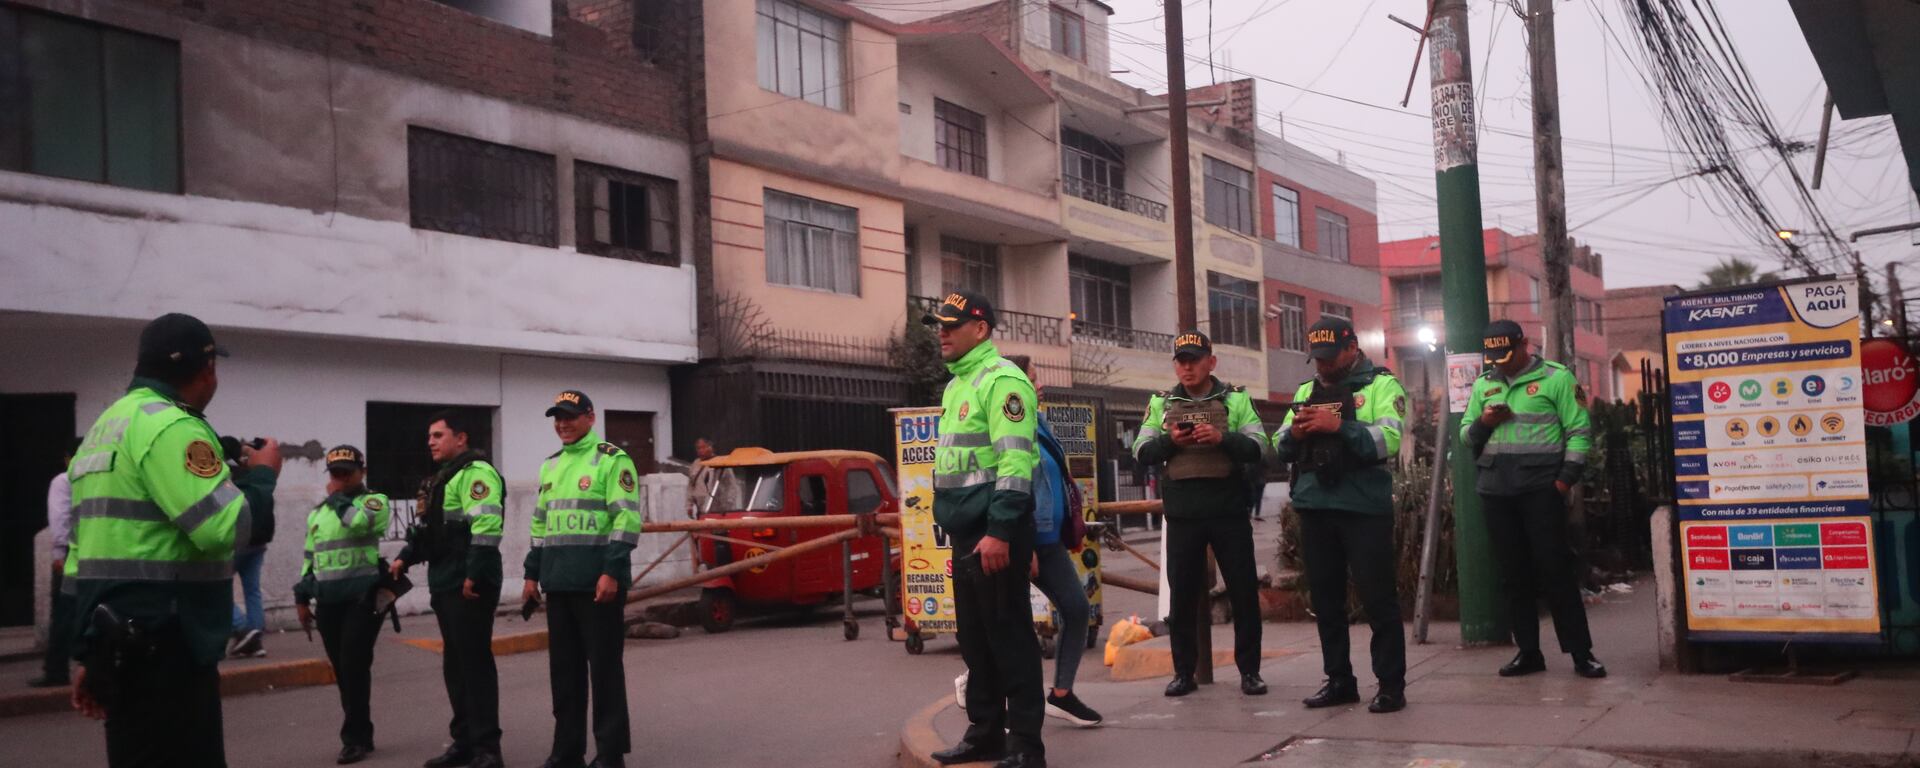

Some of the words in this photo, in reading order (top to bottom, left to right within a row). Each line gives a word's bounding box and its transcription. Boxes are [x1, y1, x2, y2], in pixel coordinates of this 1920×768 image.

[1805, 285, 1846, 298] PAGA
[1681, 298, 1713, 307] AGENTE
[1715, 292, 1764, 303] MULTIBANCO
[1806, 299, 1846, 312] AQUÍ
[1688, 304, 1758, 322] KASNET
[1175, 334, 1201, 349] POLICIA
[1308, 330, 1335, 345] POLICIA
[1734, 337, 1768, 345] NACIONAL
[1769, 335, 1784, 343] CON
[1684, 352, 1738, 369] +8,000
[1741, 350, 1789, 362] Empresas
[1799, 345, 1845, 358] servicios
[1047, 406, 1093, 423] ACCESORIOS
[1864, 399, 1920, 425] ECARGA
[1701, 508, 1718, 516] Con
[1718, 508, 1734, 516] más
[1758, 506, 1799, 514] entidades
[1800, 505, 1845, 513] financieras
[907, 574, 944, 583] RECARGAS
[908, 585, 945, 593] VIRTUALES
